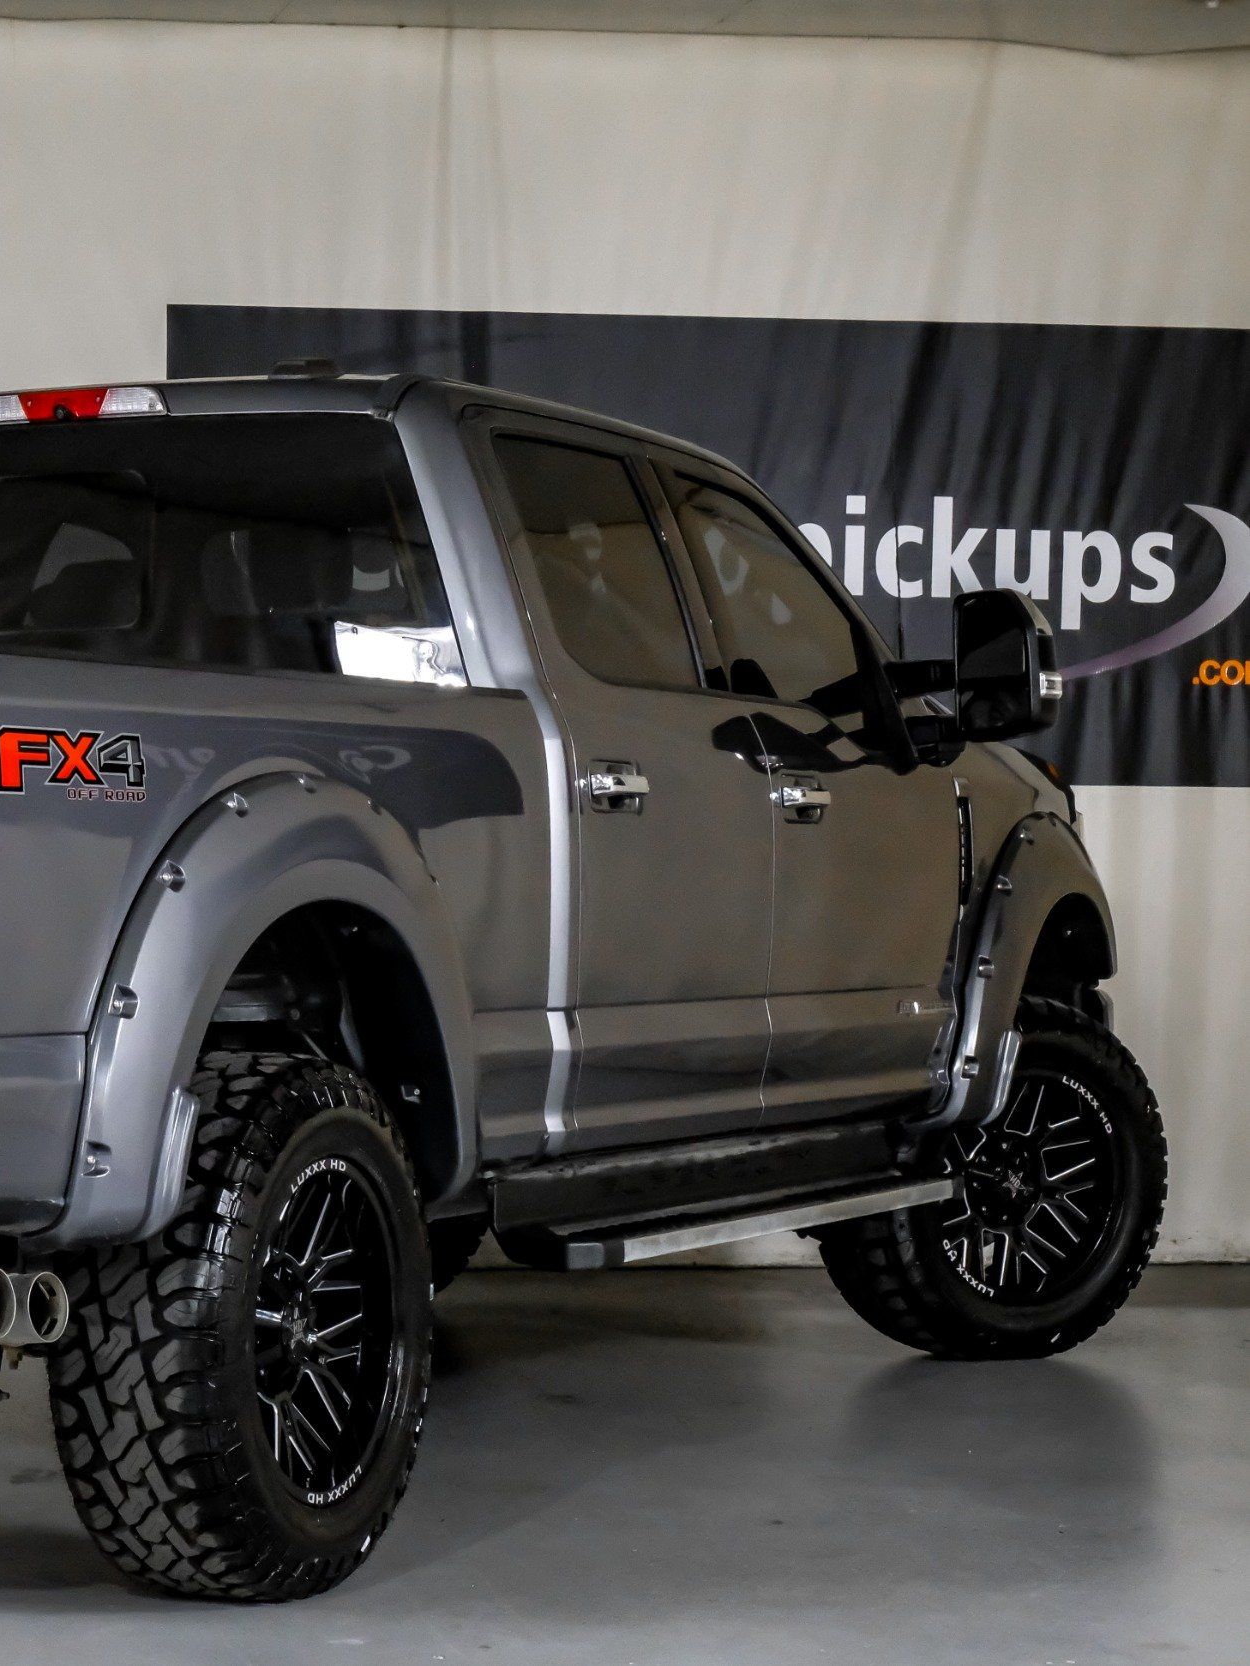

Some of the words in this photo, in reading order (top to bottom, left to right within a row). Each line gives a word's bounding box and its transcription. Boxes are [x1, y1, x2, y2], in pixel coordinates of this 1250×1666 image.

[798, 495, 1176, 630] ickups
[1192, 659, 1250, 686] .co
[67, 788, 99, 801] OFF
[104, 789, 147, 802] ROAD
[1062, 1076, 1099, 1109] LUXXX
[1100, 1111, 1112, 1133] HD
[291, 1159, 326, 1193] LUXXX
[330, 1159, 346, 1171] HD
[308, 1493, 323, 1504] HD
[328, 1465, 362, 1502] LUXXX
